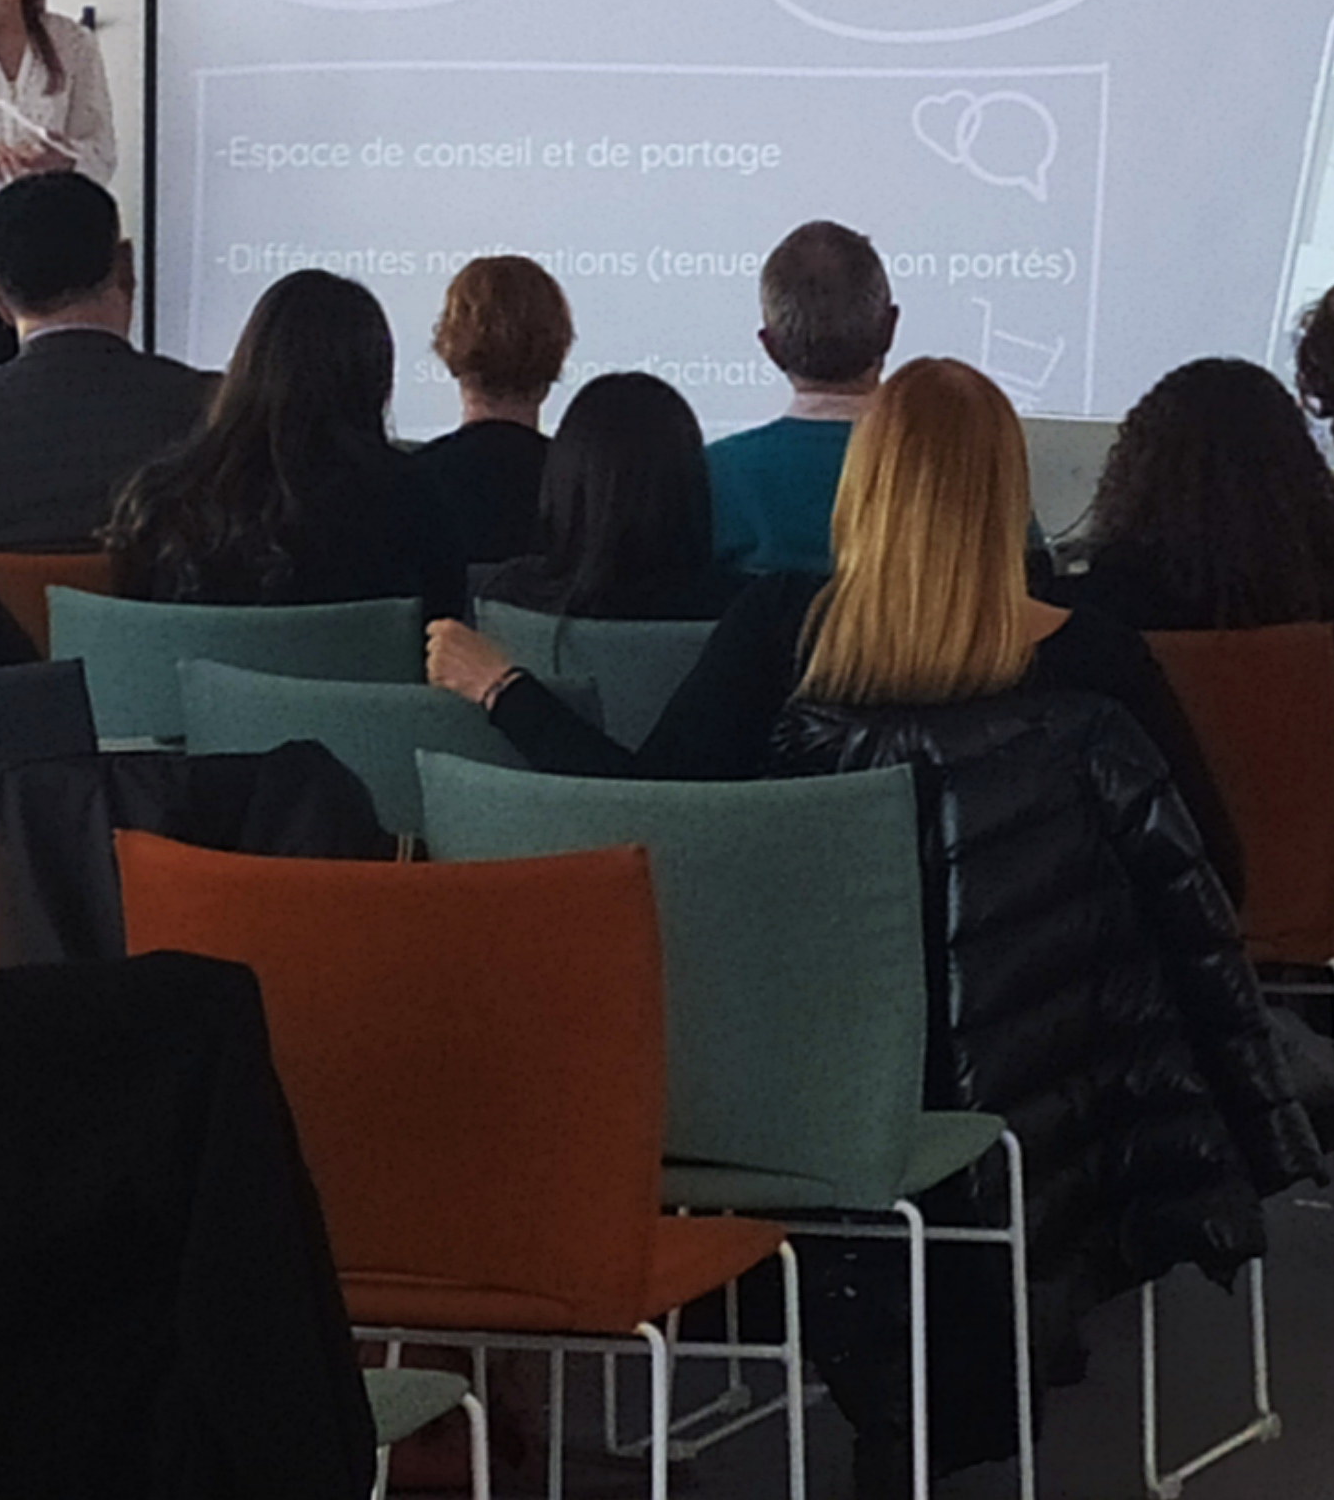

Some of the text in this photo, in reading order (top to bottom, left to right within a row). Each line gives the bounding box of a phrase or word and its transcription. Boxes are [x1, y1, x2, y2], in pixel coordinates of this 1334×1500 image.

[215, 135, 783, 178] -Espace de conseil et de partage
[427, 243, 637, 276] noations
[646, 246, 767, 283] (tenue
[949, 248, 1076, 285] portés)
